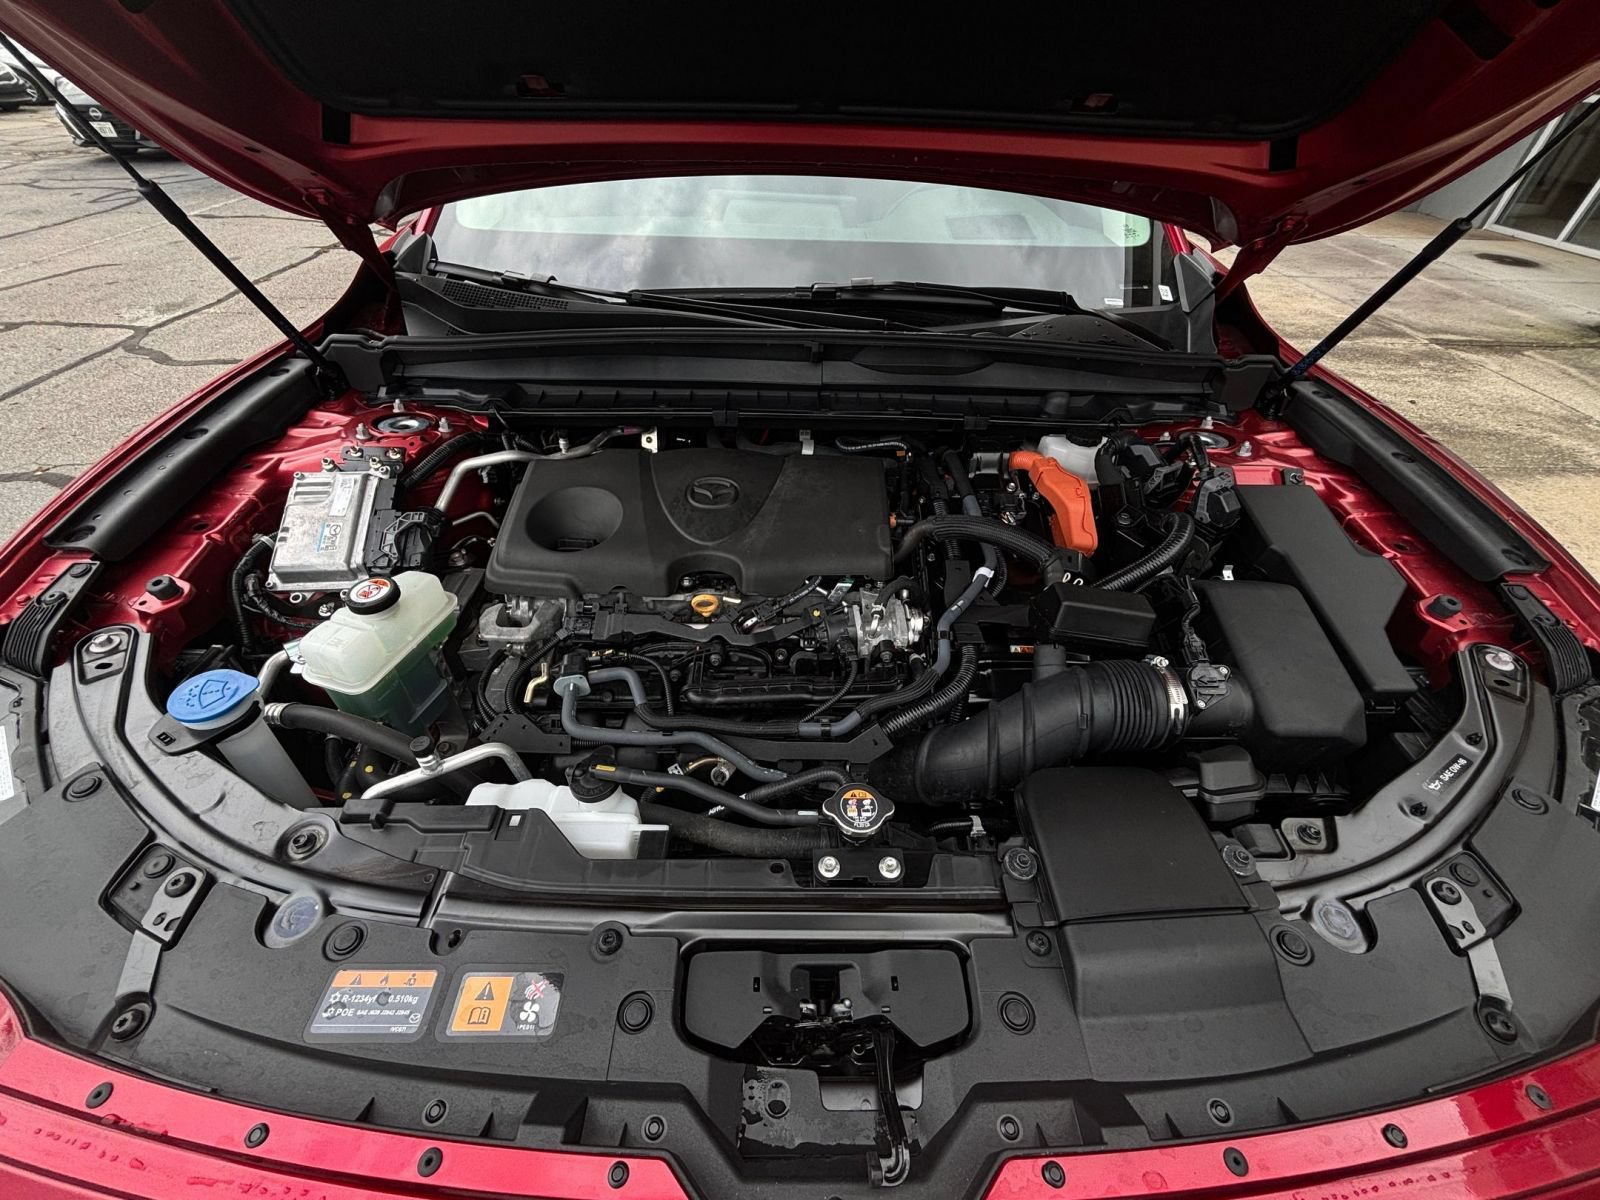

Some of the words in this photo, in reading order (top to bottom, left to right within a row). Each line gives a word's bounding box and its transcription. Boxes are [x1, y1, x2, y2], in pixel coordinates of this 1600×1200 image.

[341, 994, 378, 1005] R-1234yf
[388, 994, 419, 1005] 0.510kg
[335, 1008, 355, 1017] POE
